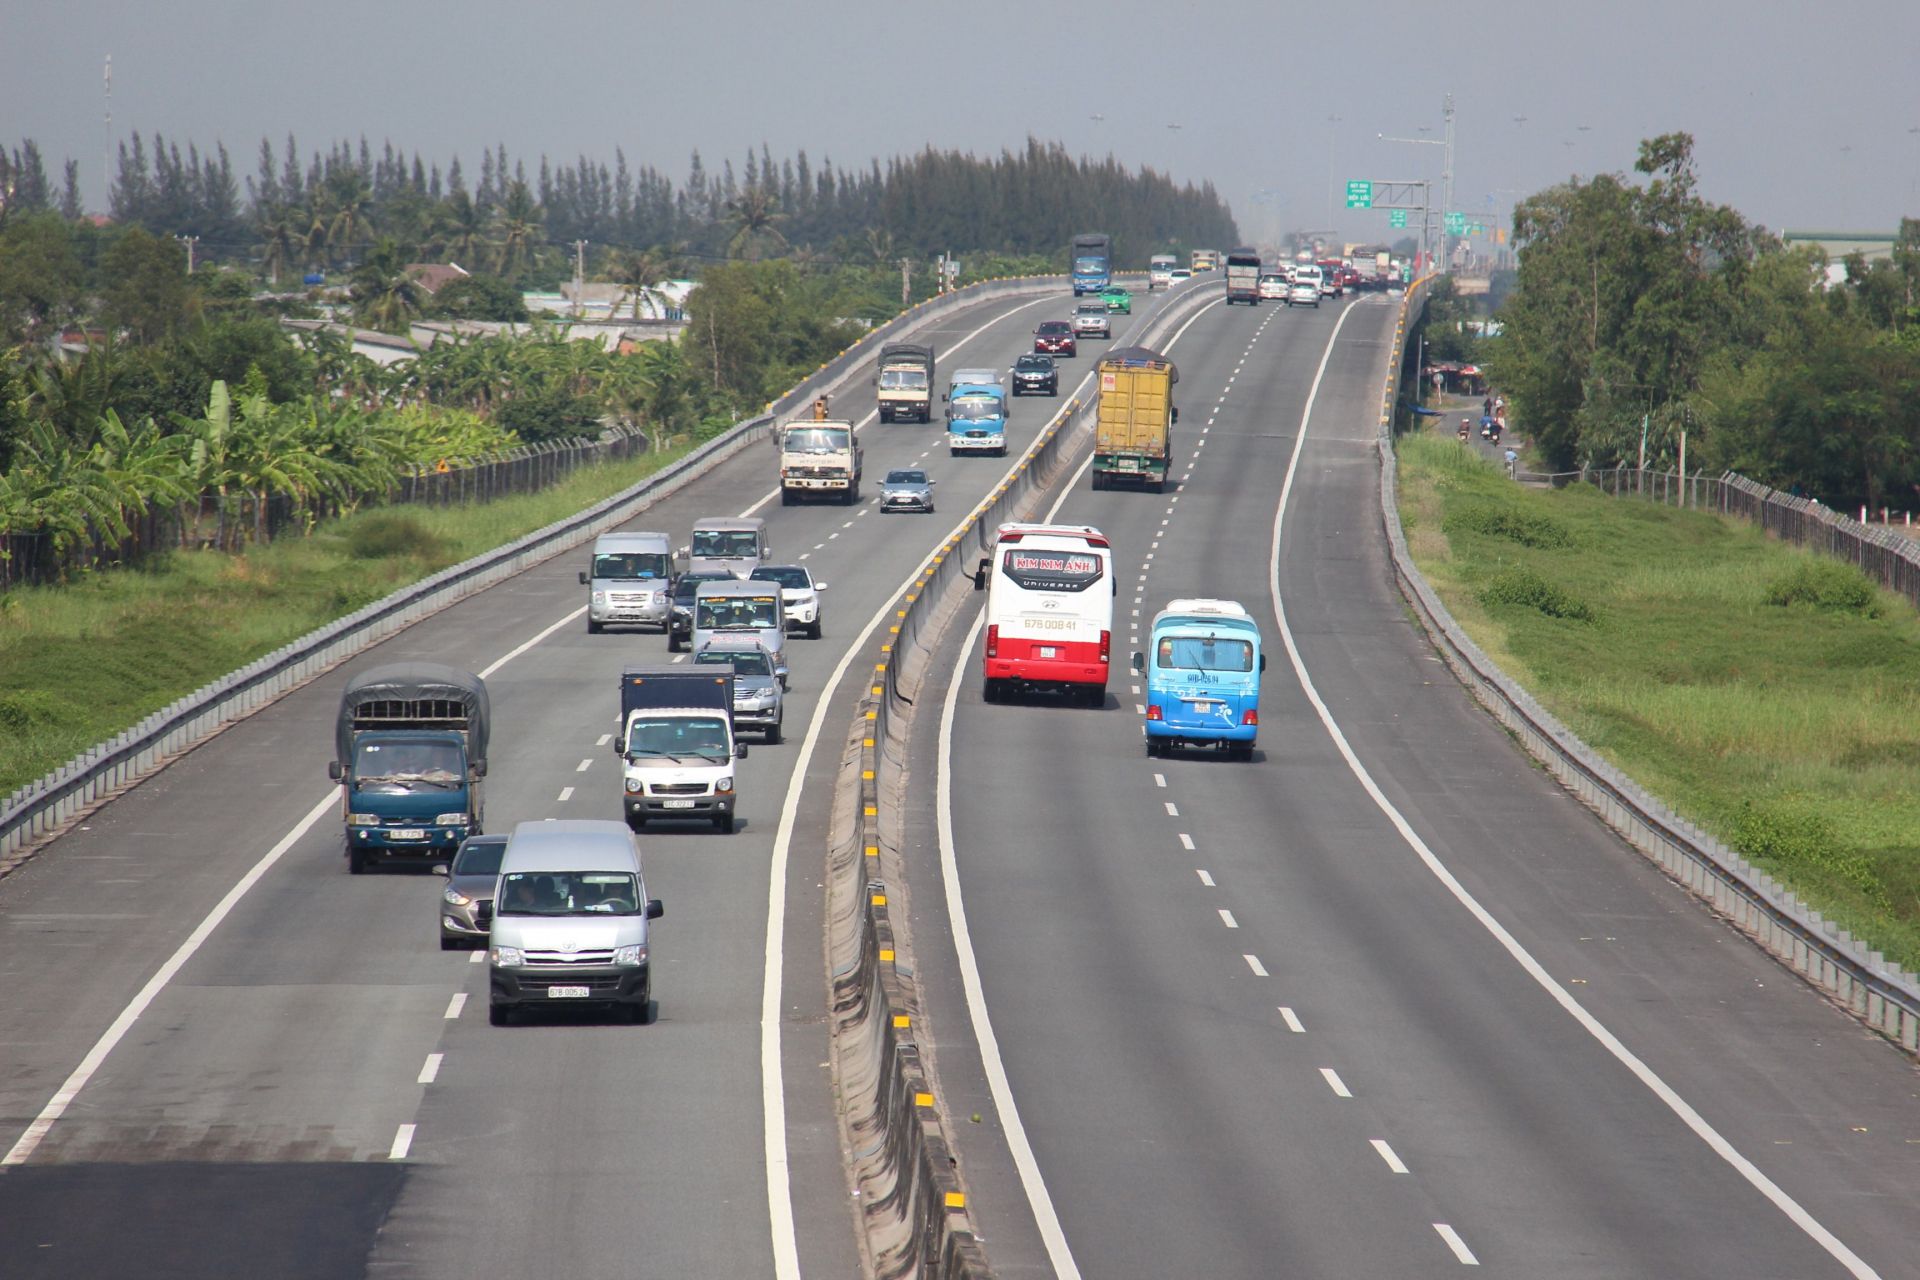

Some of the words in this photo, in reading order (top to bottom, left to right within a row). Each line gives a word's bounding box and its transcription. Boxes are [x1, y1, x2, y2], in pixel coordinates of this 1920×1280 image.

[1016, 558, 1038, 569] KIM
[1040, 559, 1063, 570] KIM
[1064, 561, 1090, 571] ANH
